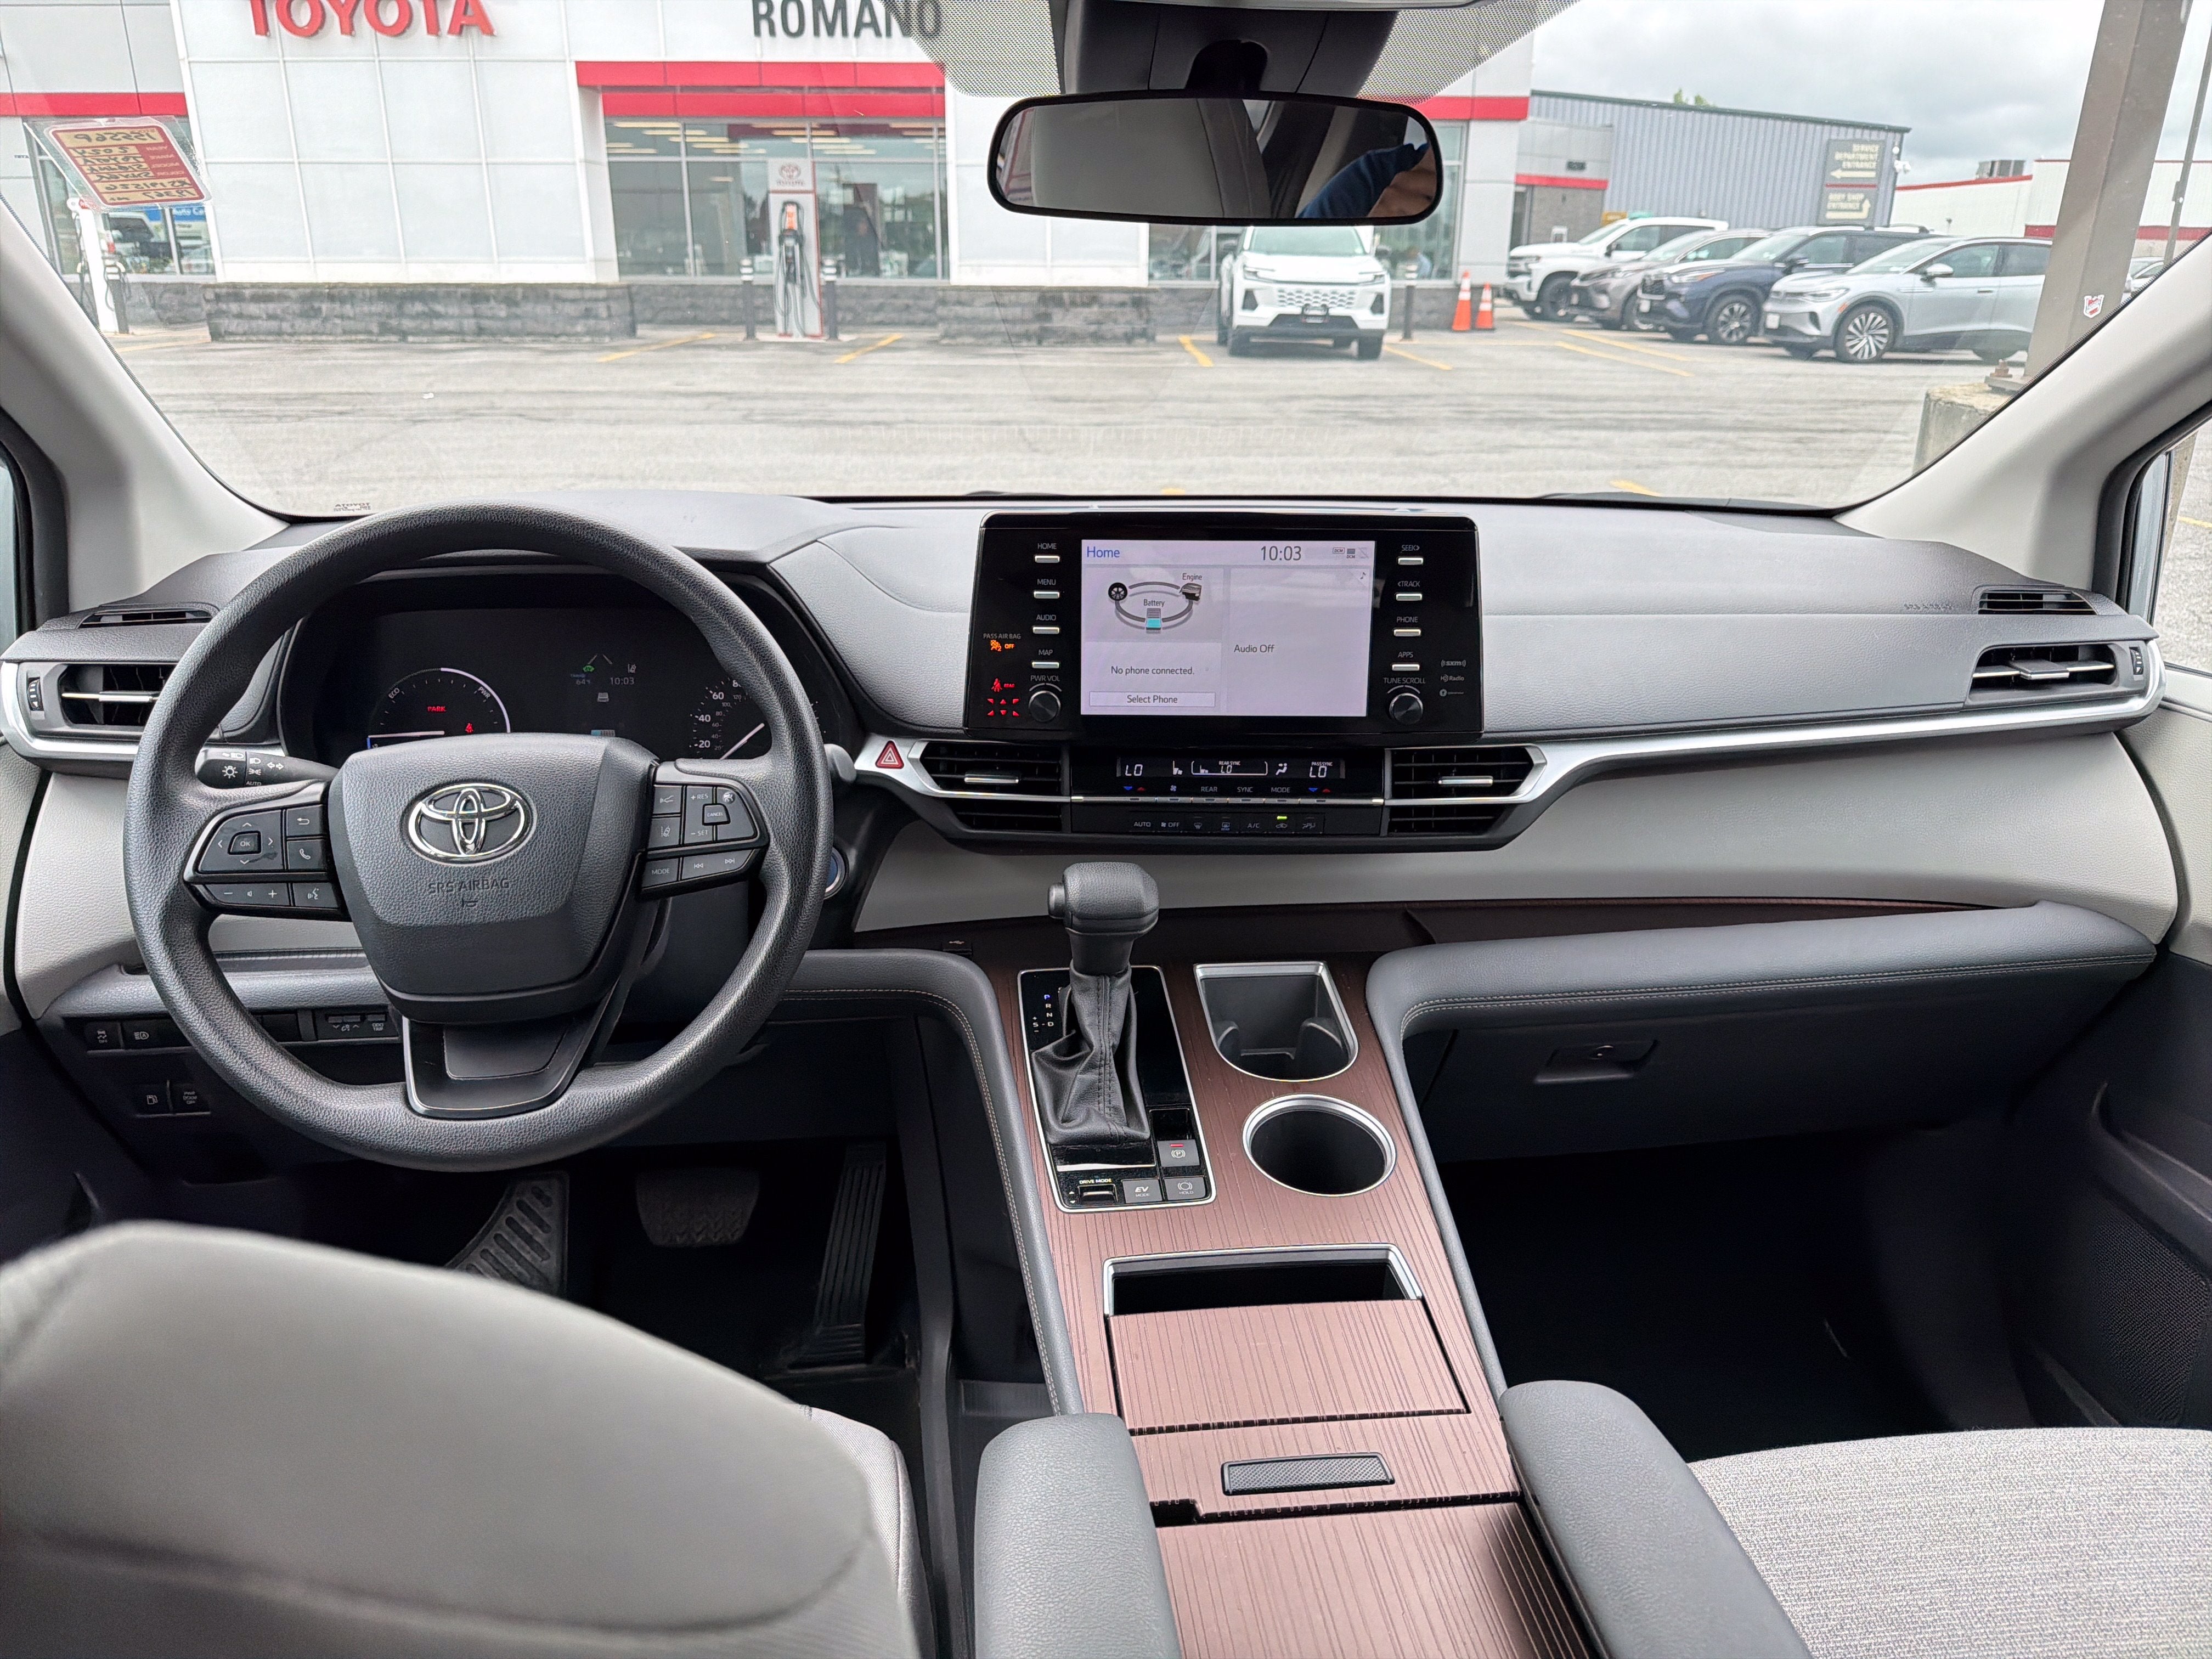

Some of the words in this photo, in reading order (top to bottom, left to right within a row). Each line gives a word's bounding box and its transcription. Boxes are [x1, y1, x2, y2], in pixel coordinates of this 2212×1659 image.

[249, 0, 497, 37] TOYOTA
[752, 0, 941, 38] ROMANO
[1086, 546, 1120, 558] Home
[1260, 545, 1302, 561] 10:03
[1182, 573, 1203, 582] Engine
[1143, 599, 1165, 607] Battery
[1233, 644, 1258, 653] Audio
[1259, 644, 1275, 653] Off
[1111, 666, 1123, 675] No
[1125, 666, 1150, 676] phone
[1151, 666, 1195, 675] connected.
[610, 677, 635, 685] 10:03
[387, 687, 400, 699] ECO
[477, 686, 492, 699] PWR
[712, 692, 724, 700] 60
[1126, 695, 1150, 704] Select
[1153, 695, 1178, 704] Phone
[698, 740, 710, 748] 20
[1125, 764, 1143, 776] LO
[1220, 765, 1233, 774] LO
[1309, 765, 1327, 777] LO
[459, 878, 510, 893] AIRBAG
